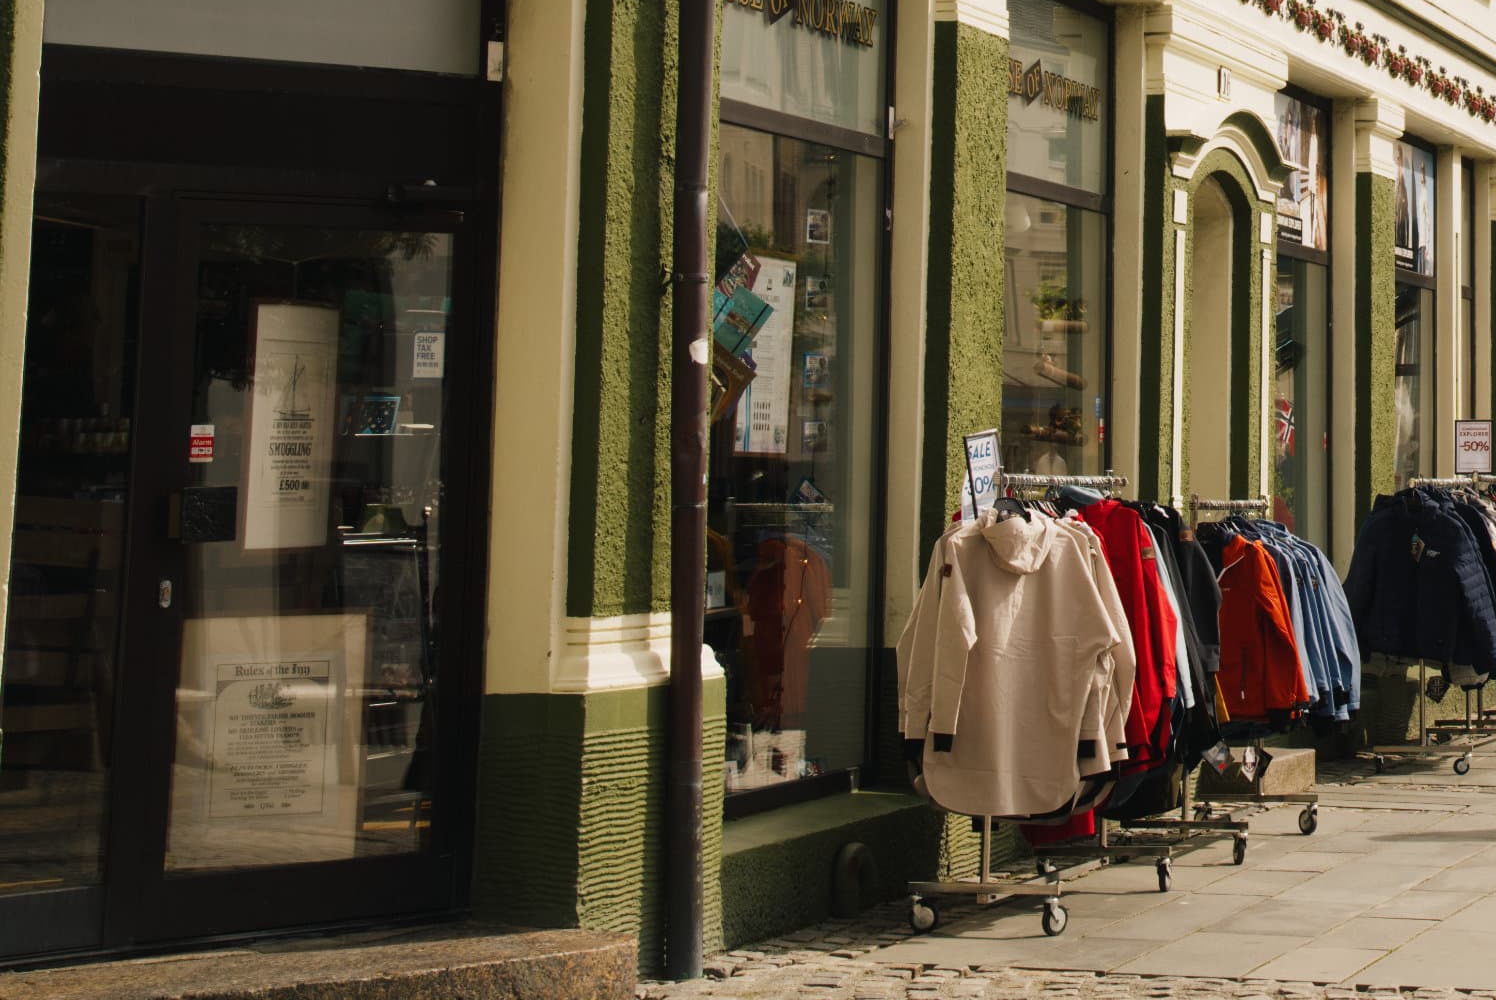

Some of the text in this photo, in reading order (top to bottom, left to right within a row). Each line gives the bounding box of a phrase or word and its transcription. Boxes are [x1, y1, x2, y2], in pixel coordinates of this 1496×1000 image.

[1027, 64, 1040, 98] OF
[1044, 70, 1101, 121] NORWAY
[416, 335, 439, 344] SHOP
[416, 344, 432, 352] TAX
[416, 352, 436, 360] FREE
[268, 442, 312, 457] SMUGGLING
[967, 441, 992, 459] SALE
[1459, 440, 1489, 452] -50%
[279, 479, 301, 491] £500
[235, 665, 265, 677] Rules
[274, 664, 290, 675] the
